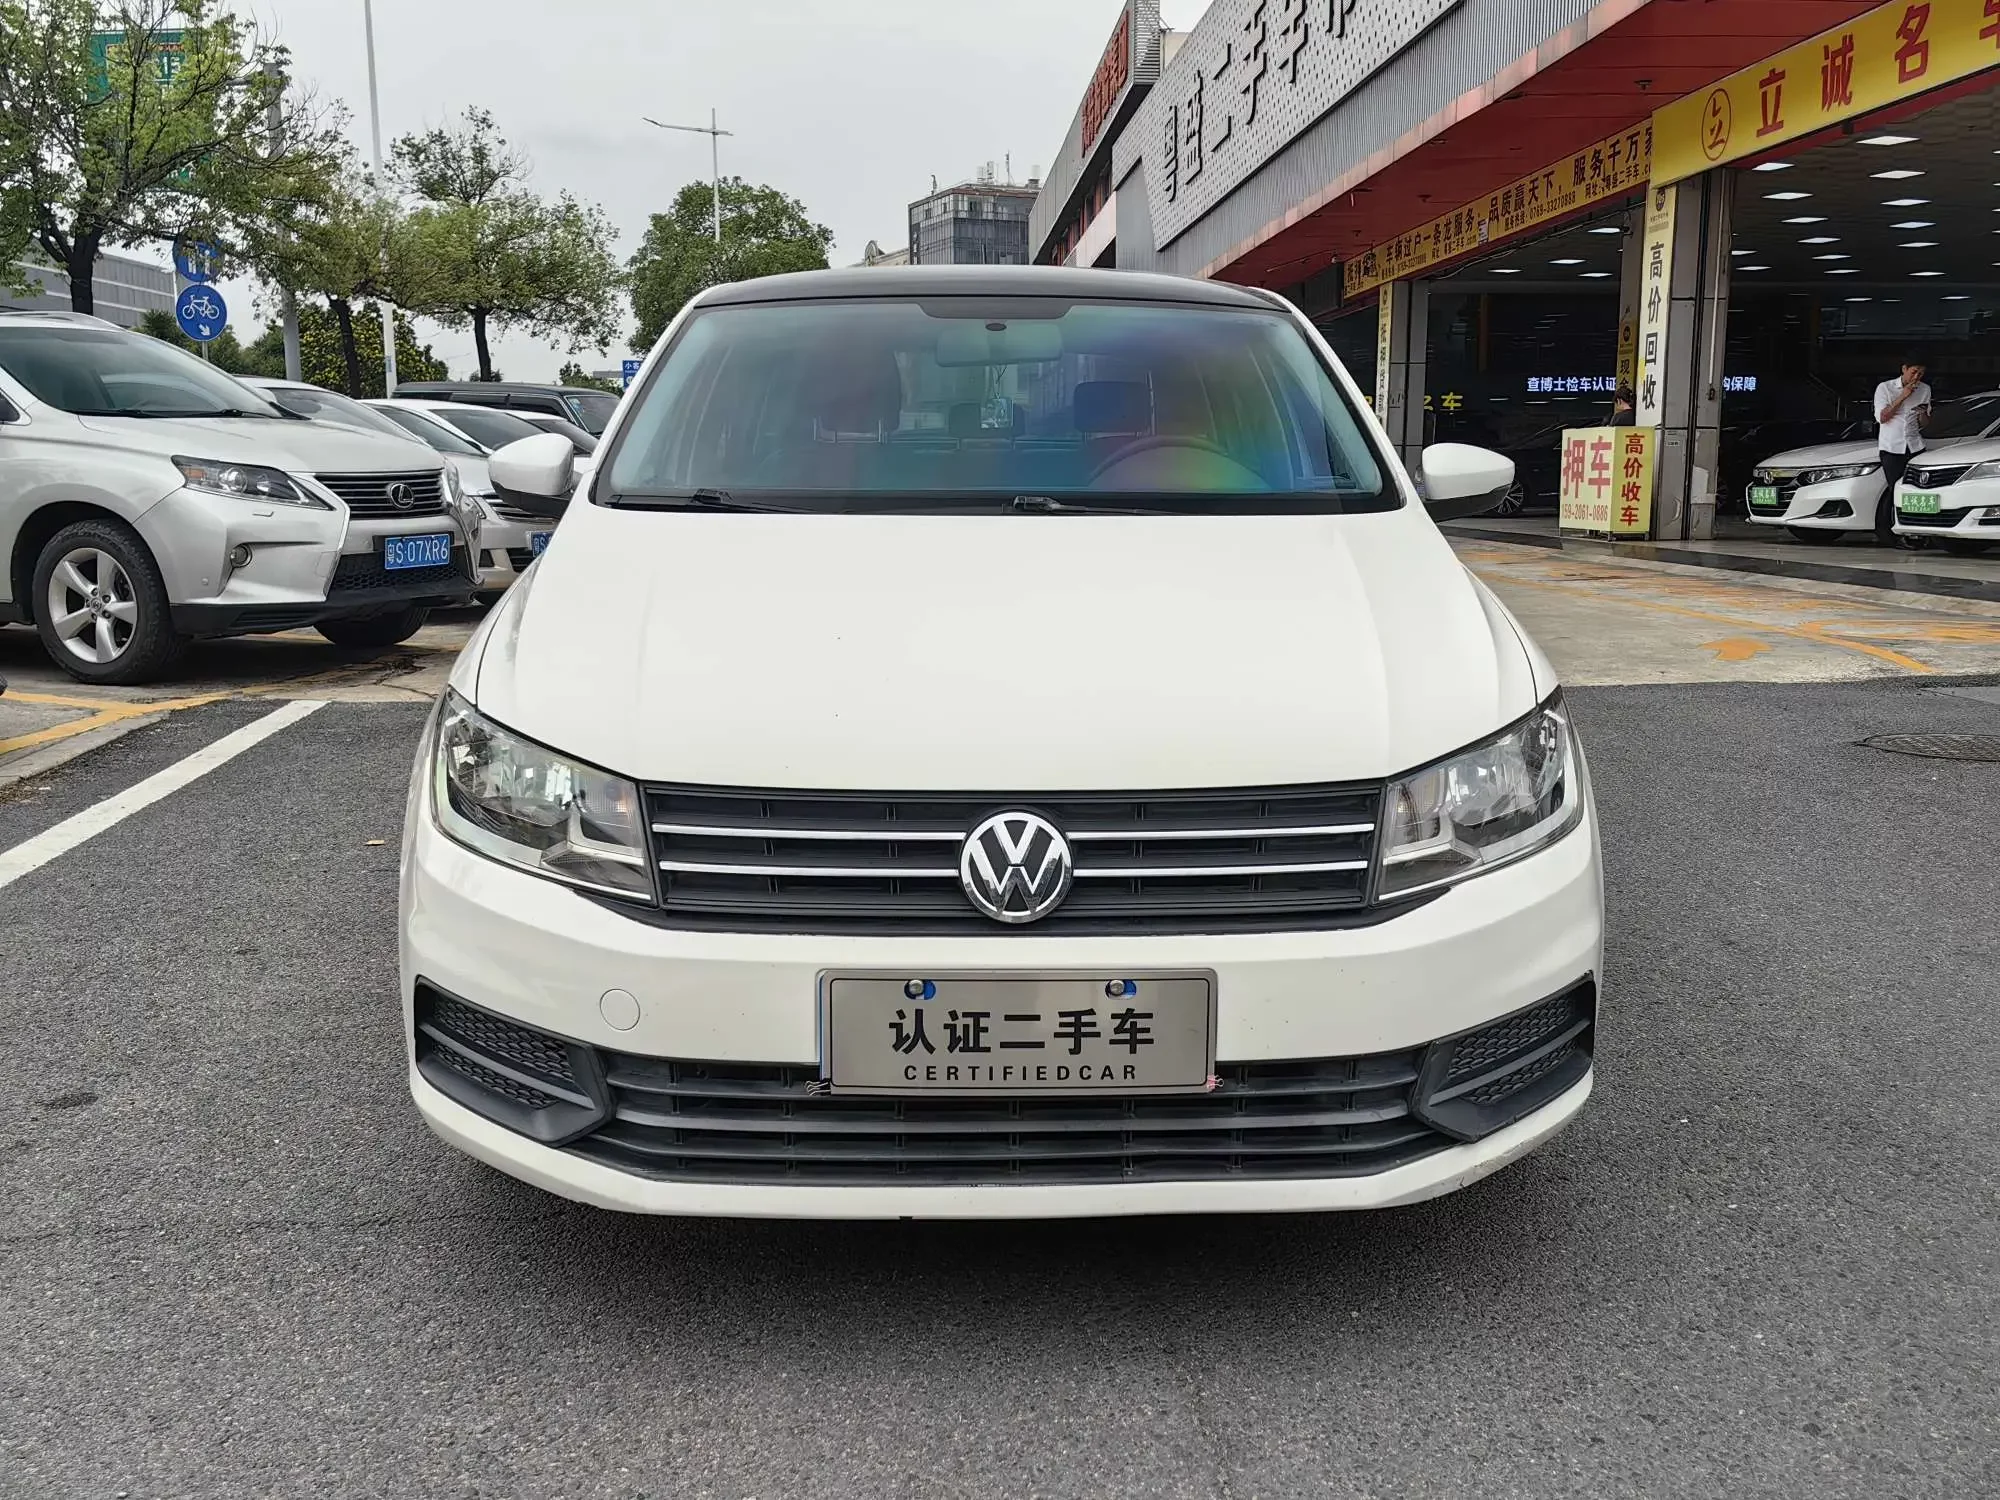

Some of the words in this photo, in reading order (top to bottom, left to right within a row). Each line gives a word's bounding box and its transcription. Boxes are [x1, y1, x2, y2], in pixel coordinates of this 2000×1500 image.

[1642, 242, 1664, 410] 高价回收
[1526, 377, 1617, 392] 查博士检车认证
[1562, 435, 1612, 499] 押车
[1620, 432, 1645, 527] 高价收车
[889, 1008, 1155, 1056] 认证二手车
[904, 1065, 1136, 1081] CERTIFIEDCAR
